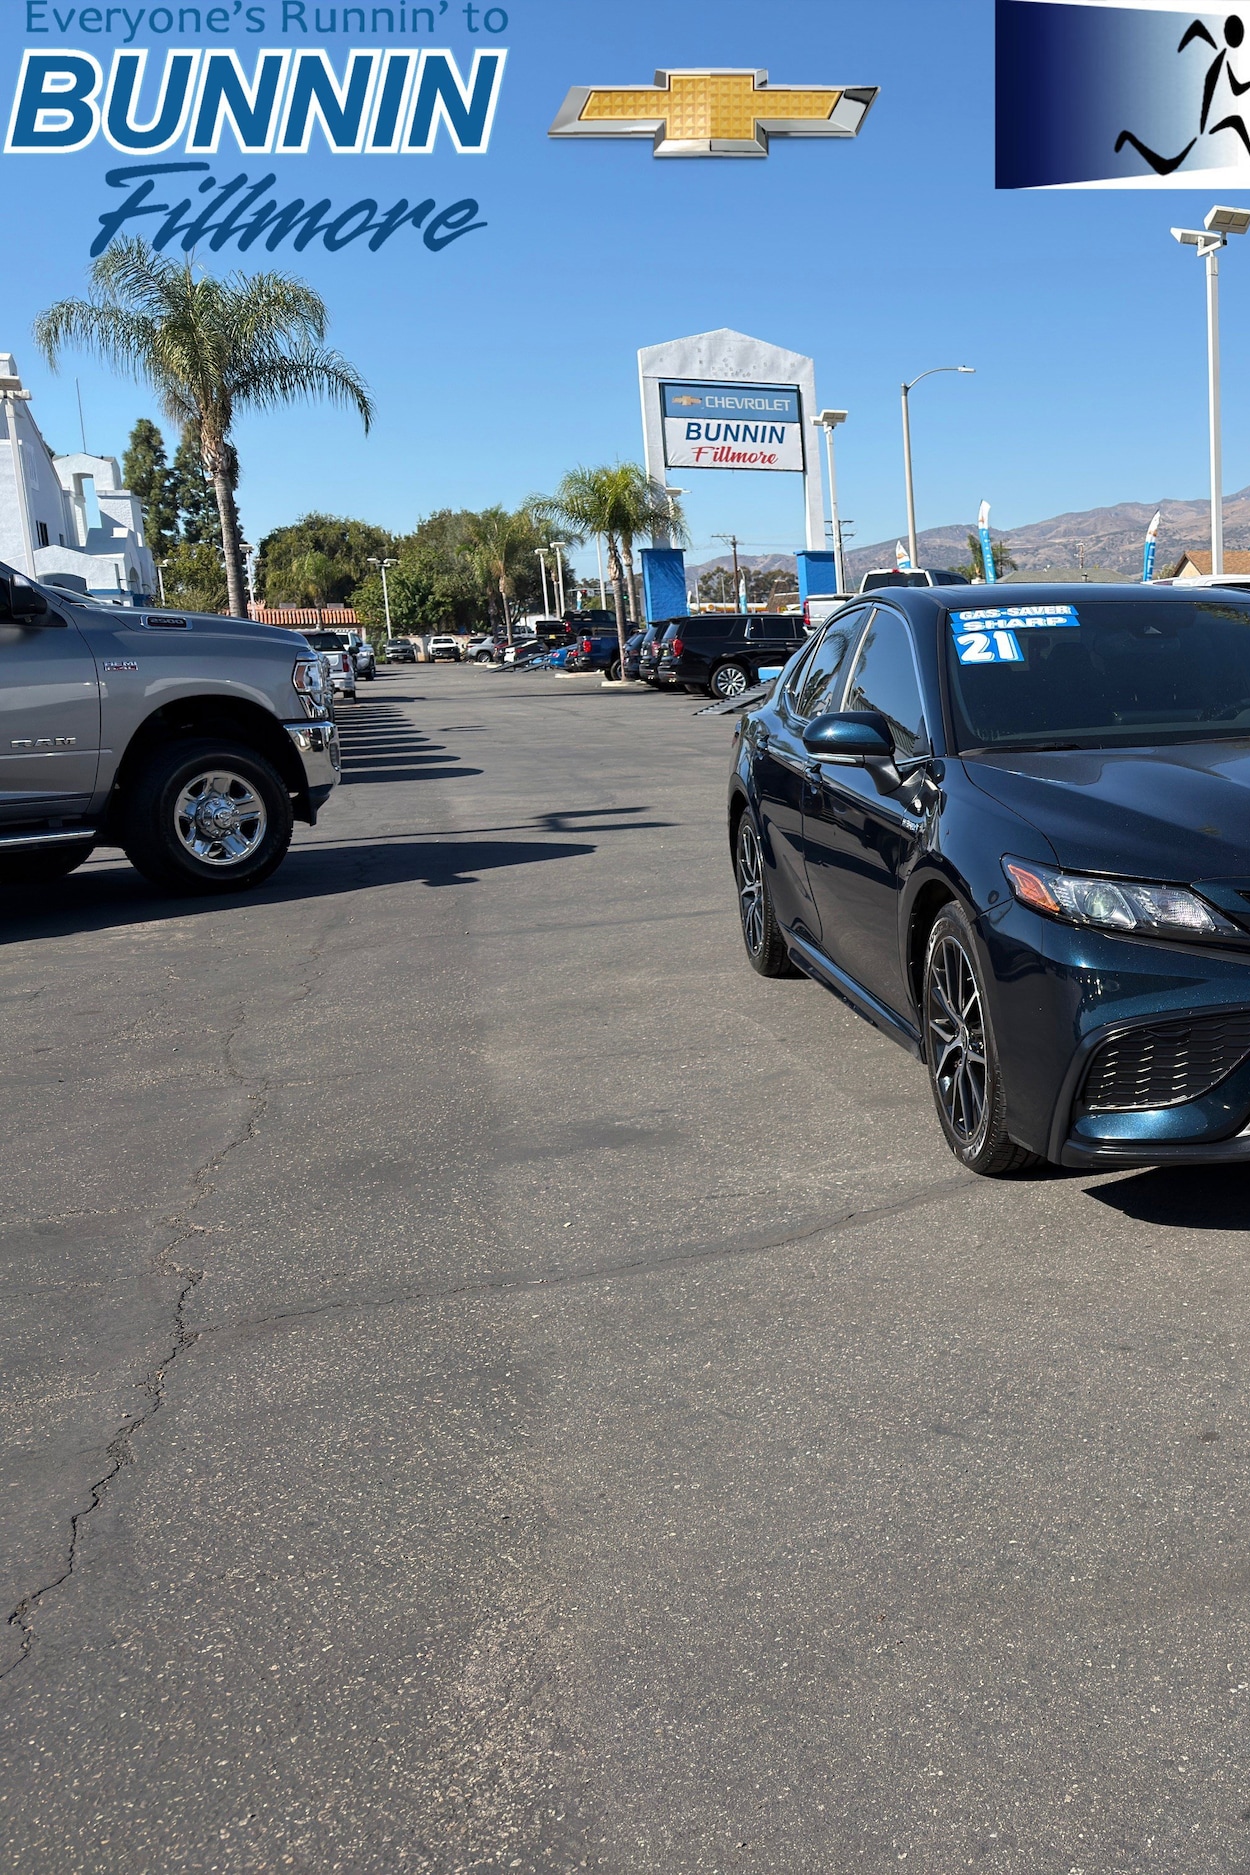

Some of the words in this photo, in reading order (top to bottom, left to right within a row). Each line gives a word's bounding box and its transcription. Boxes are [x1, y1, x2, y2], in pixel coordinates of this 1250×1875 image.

[705, 396, 790, 411] CHEVROLET
[685, 422, 786, 444] BUNNIN
[691, 446, 779, 465] Fillmore
[959, 605, 1072, 620] GAS-SAVER
[963, 616, 1067, 631] SHARP
[957, 630, 1019, 662] 21
[10, 737, 77, 748] RAM
